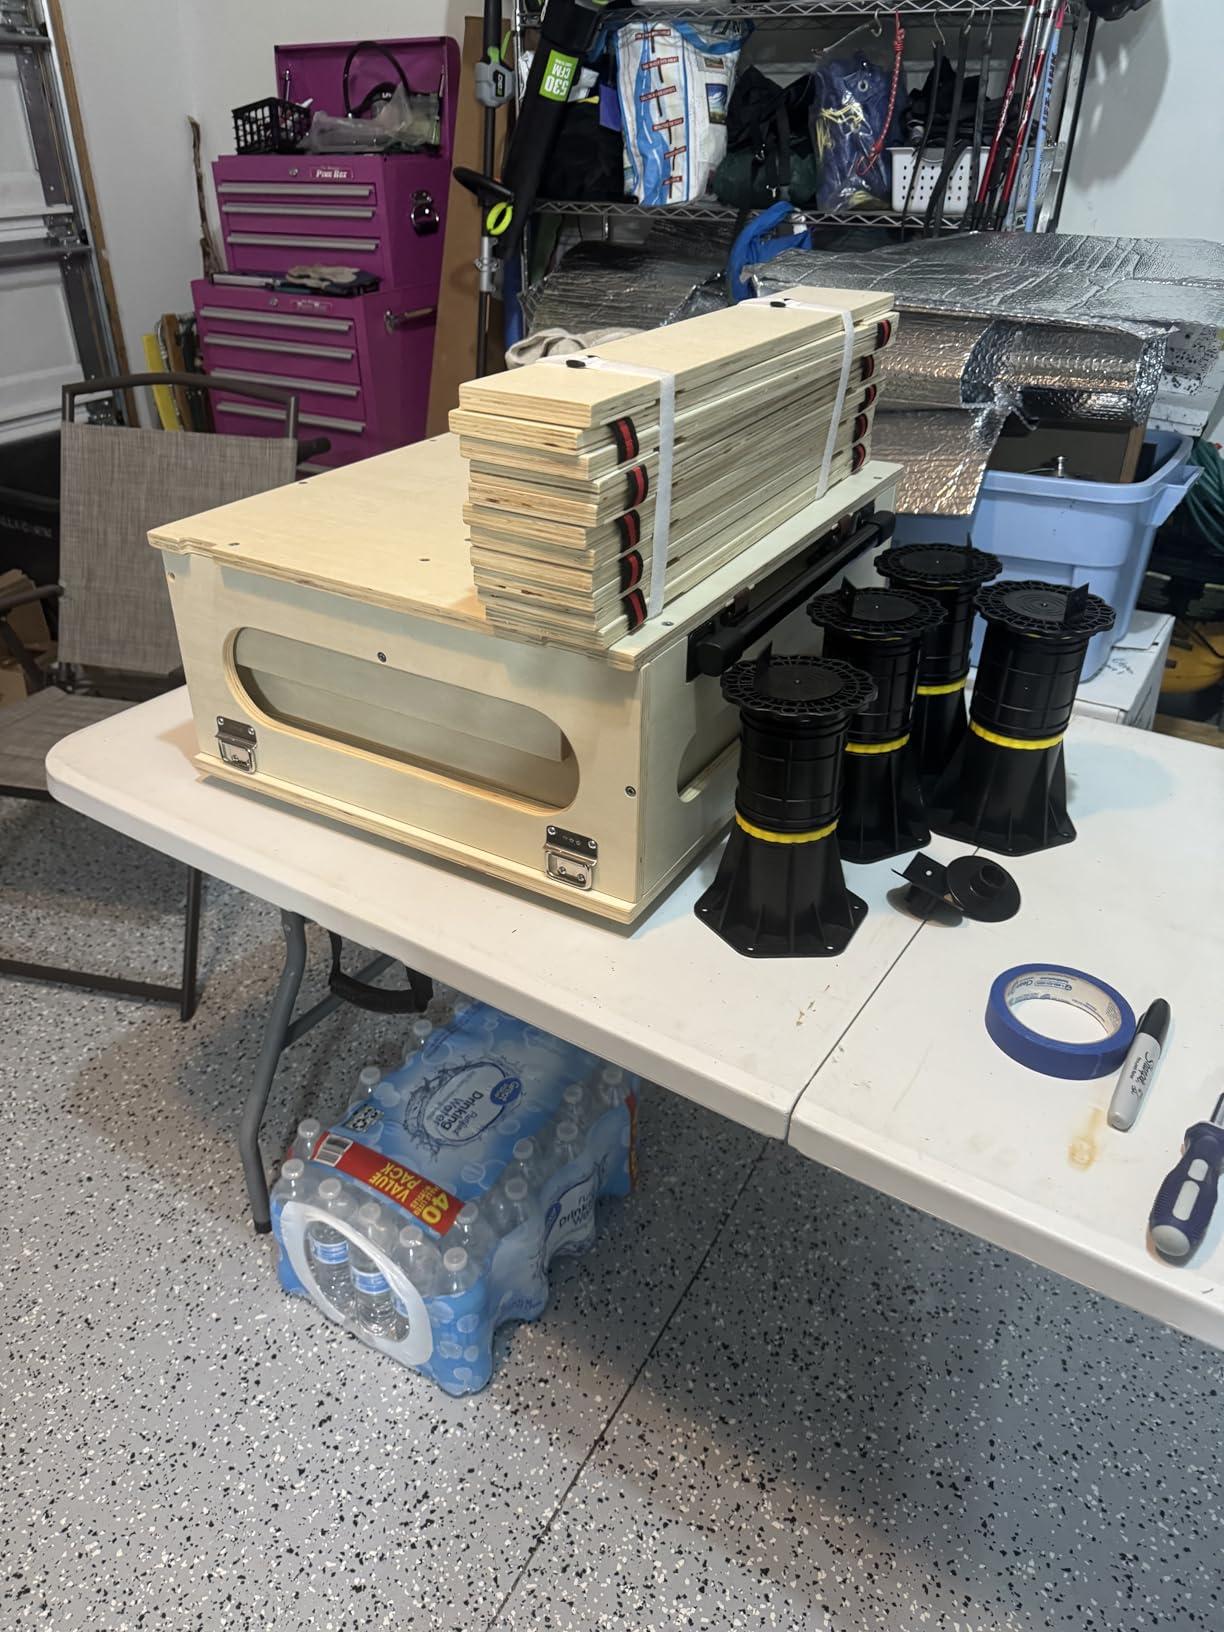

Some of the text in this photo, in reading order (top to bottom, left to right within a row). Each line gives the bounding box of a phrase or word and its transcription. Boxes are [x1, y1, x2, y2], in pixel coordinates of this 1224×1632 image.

[552, 63, 571, 79] CFM
[544, 75, 569, 96] 530
[433, 1098, 462, 1126] Water
[441, 1090, 484, 1131] Drinking
[368, 1172, 410, 1203] VALUE
[380, 1162, 422, 1190] PACK
[422, 1192, 449, 1224] 40
